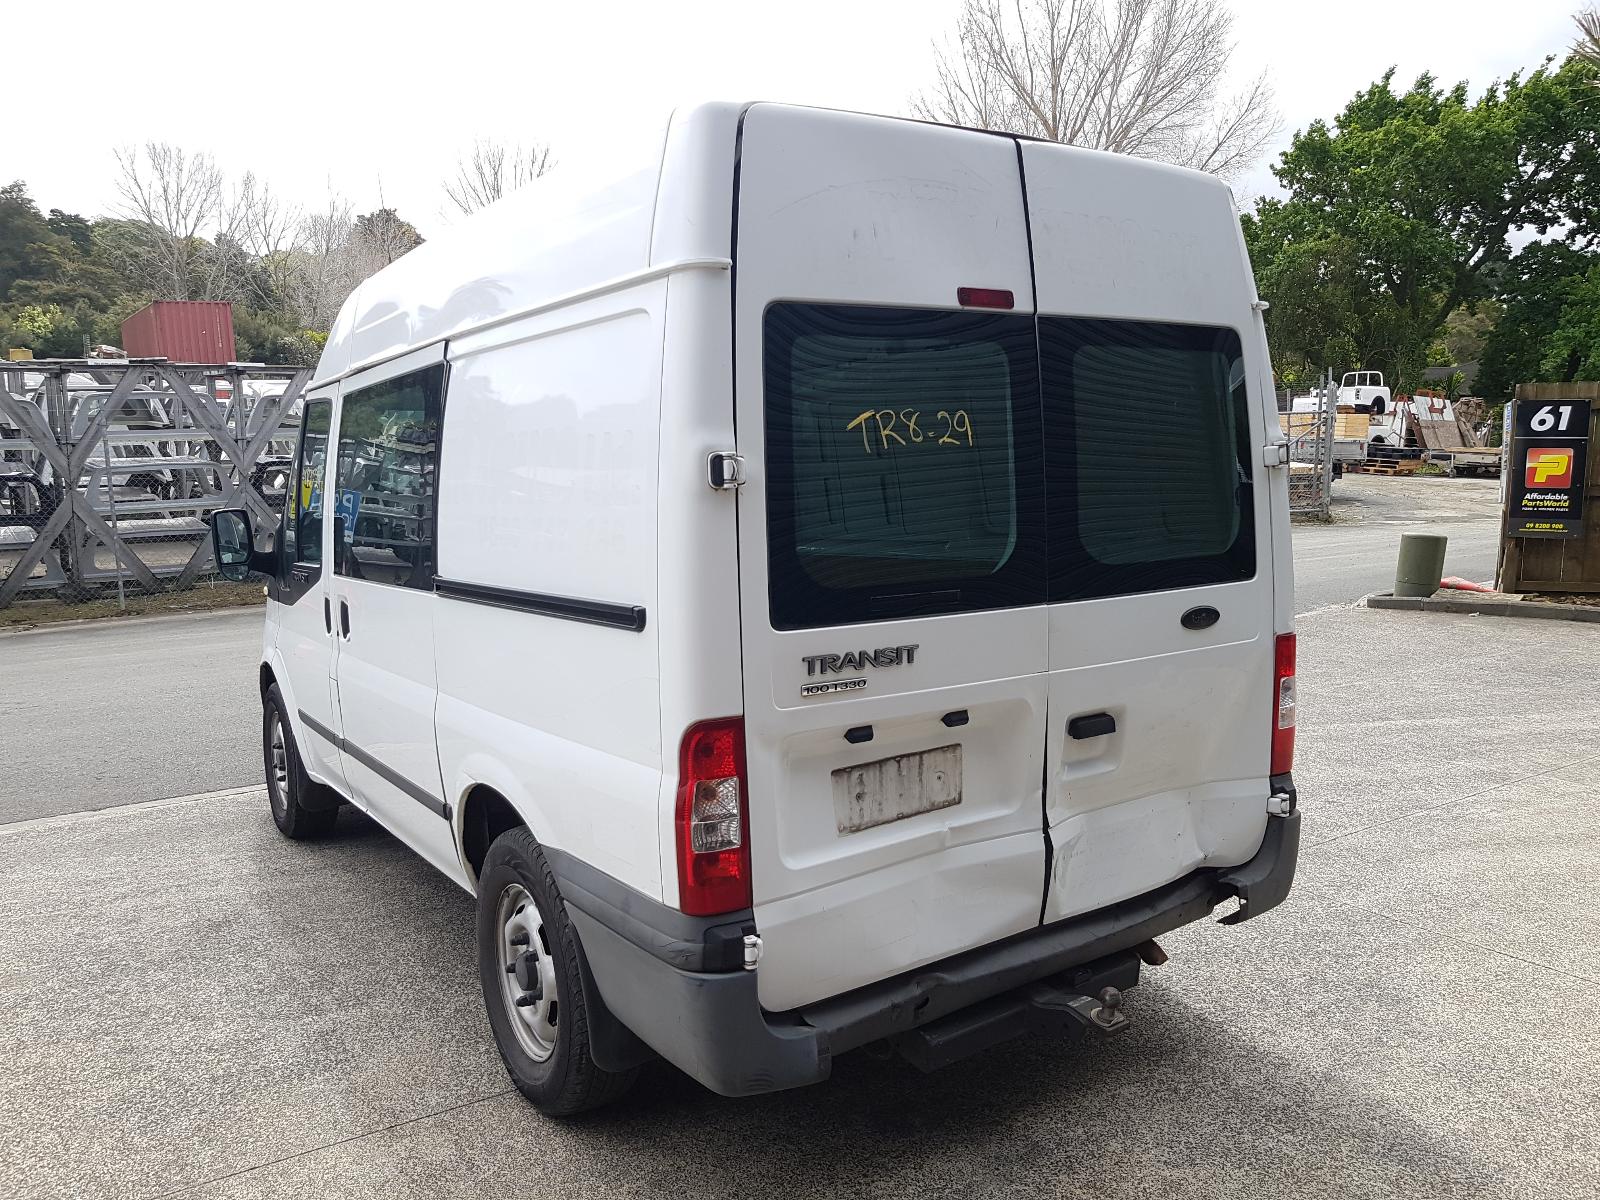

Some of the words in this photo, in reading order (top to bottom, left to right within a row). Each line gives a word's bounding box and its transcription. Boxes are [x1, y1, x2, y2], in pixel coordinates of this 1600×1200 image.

[1530, 405, 1572, 432] 61
[802, 644, 920, 676] TRANSIT
[803, 685, 829, 695] 100
